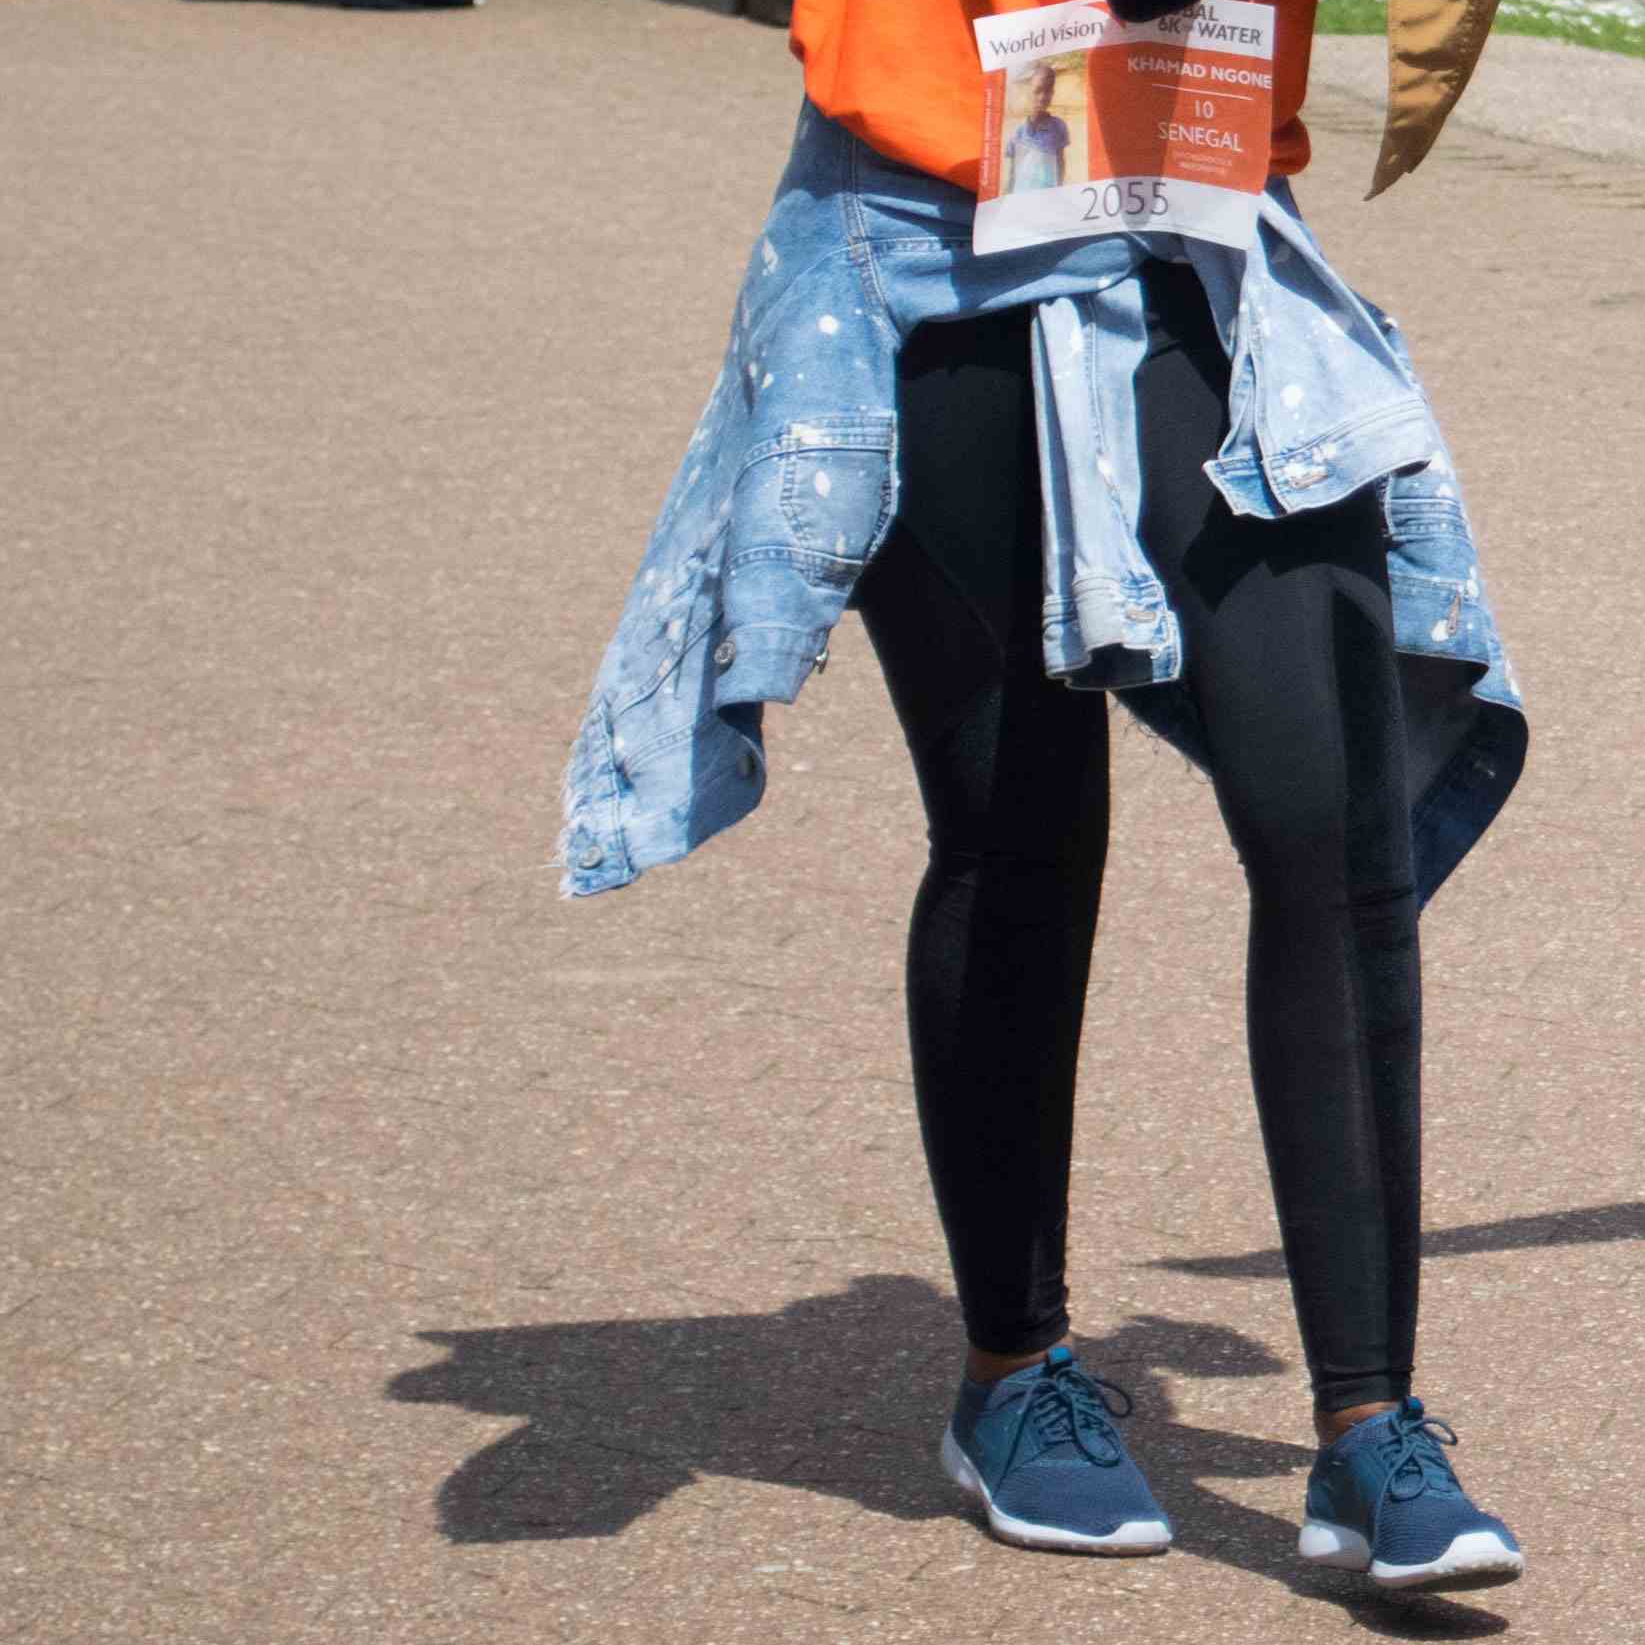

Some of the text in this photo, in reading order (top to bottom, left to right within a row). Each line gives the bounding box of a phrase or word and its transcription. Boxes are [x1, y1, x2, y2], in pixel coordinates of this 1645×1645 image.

[990, 20, 1104, 56] World Vision
[1198, 22, 1263, 45] WATER
[1127, 57, 1273, 89] KHAMAD NGONE
[1195, 100, 1214, 119] 10
[1158, 121, 1243, 152] SENEGAL
[1080, 181, 1169, 221] 2055
